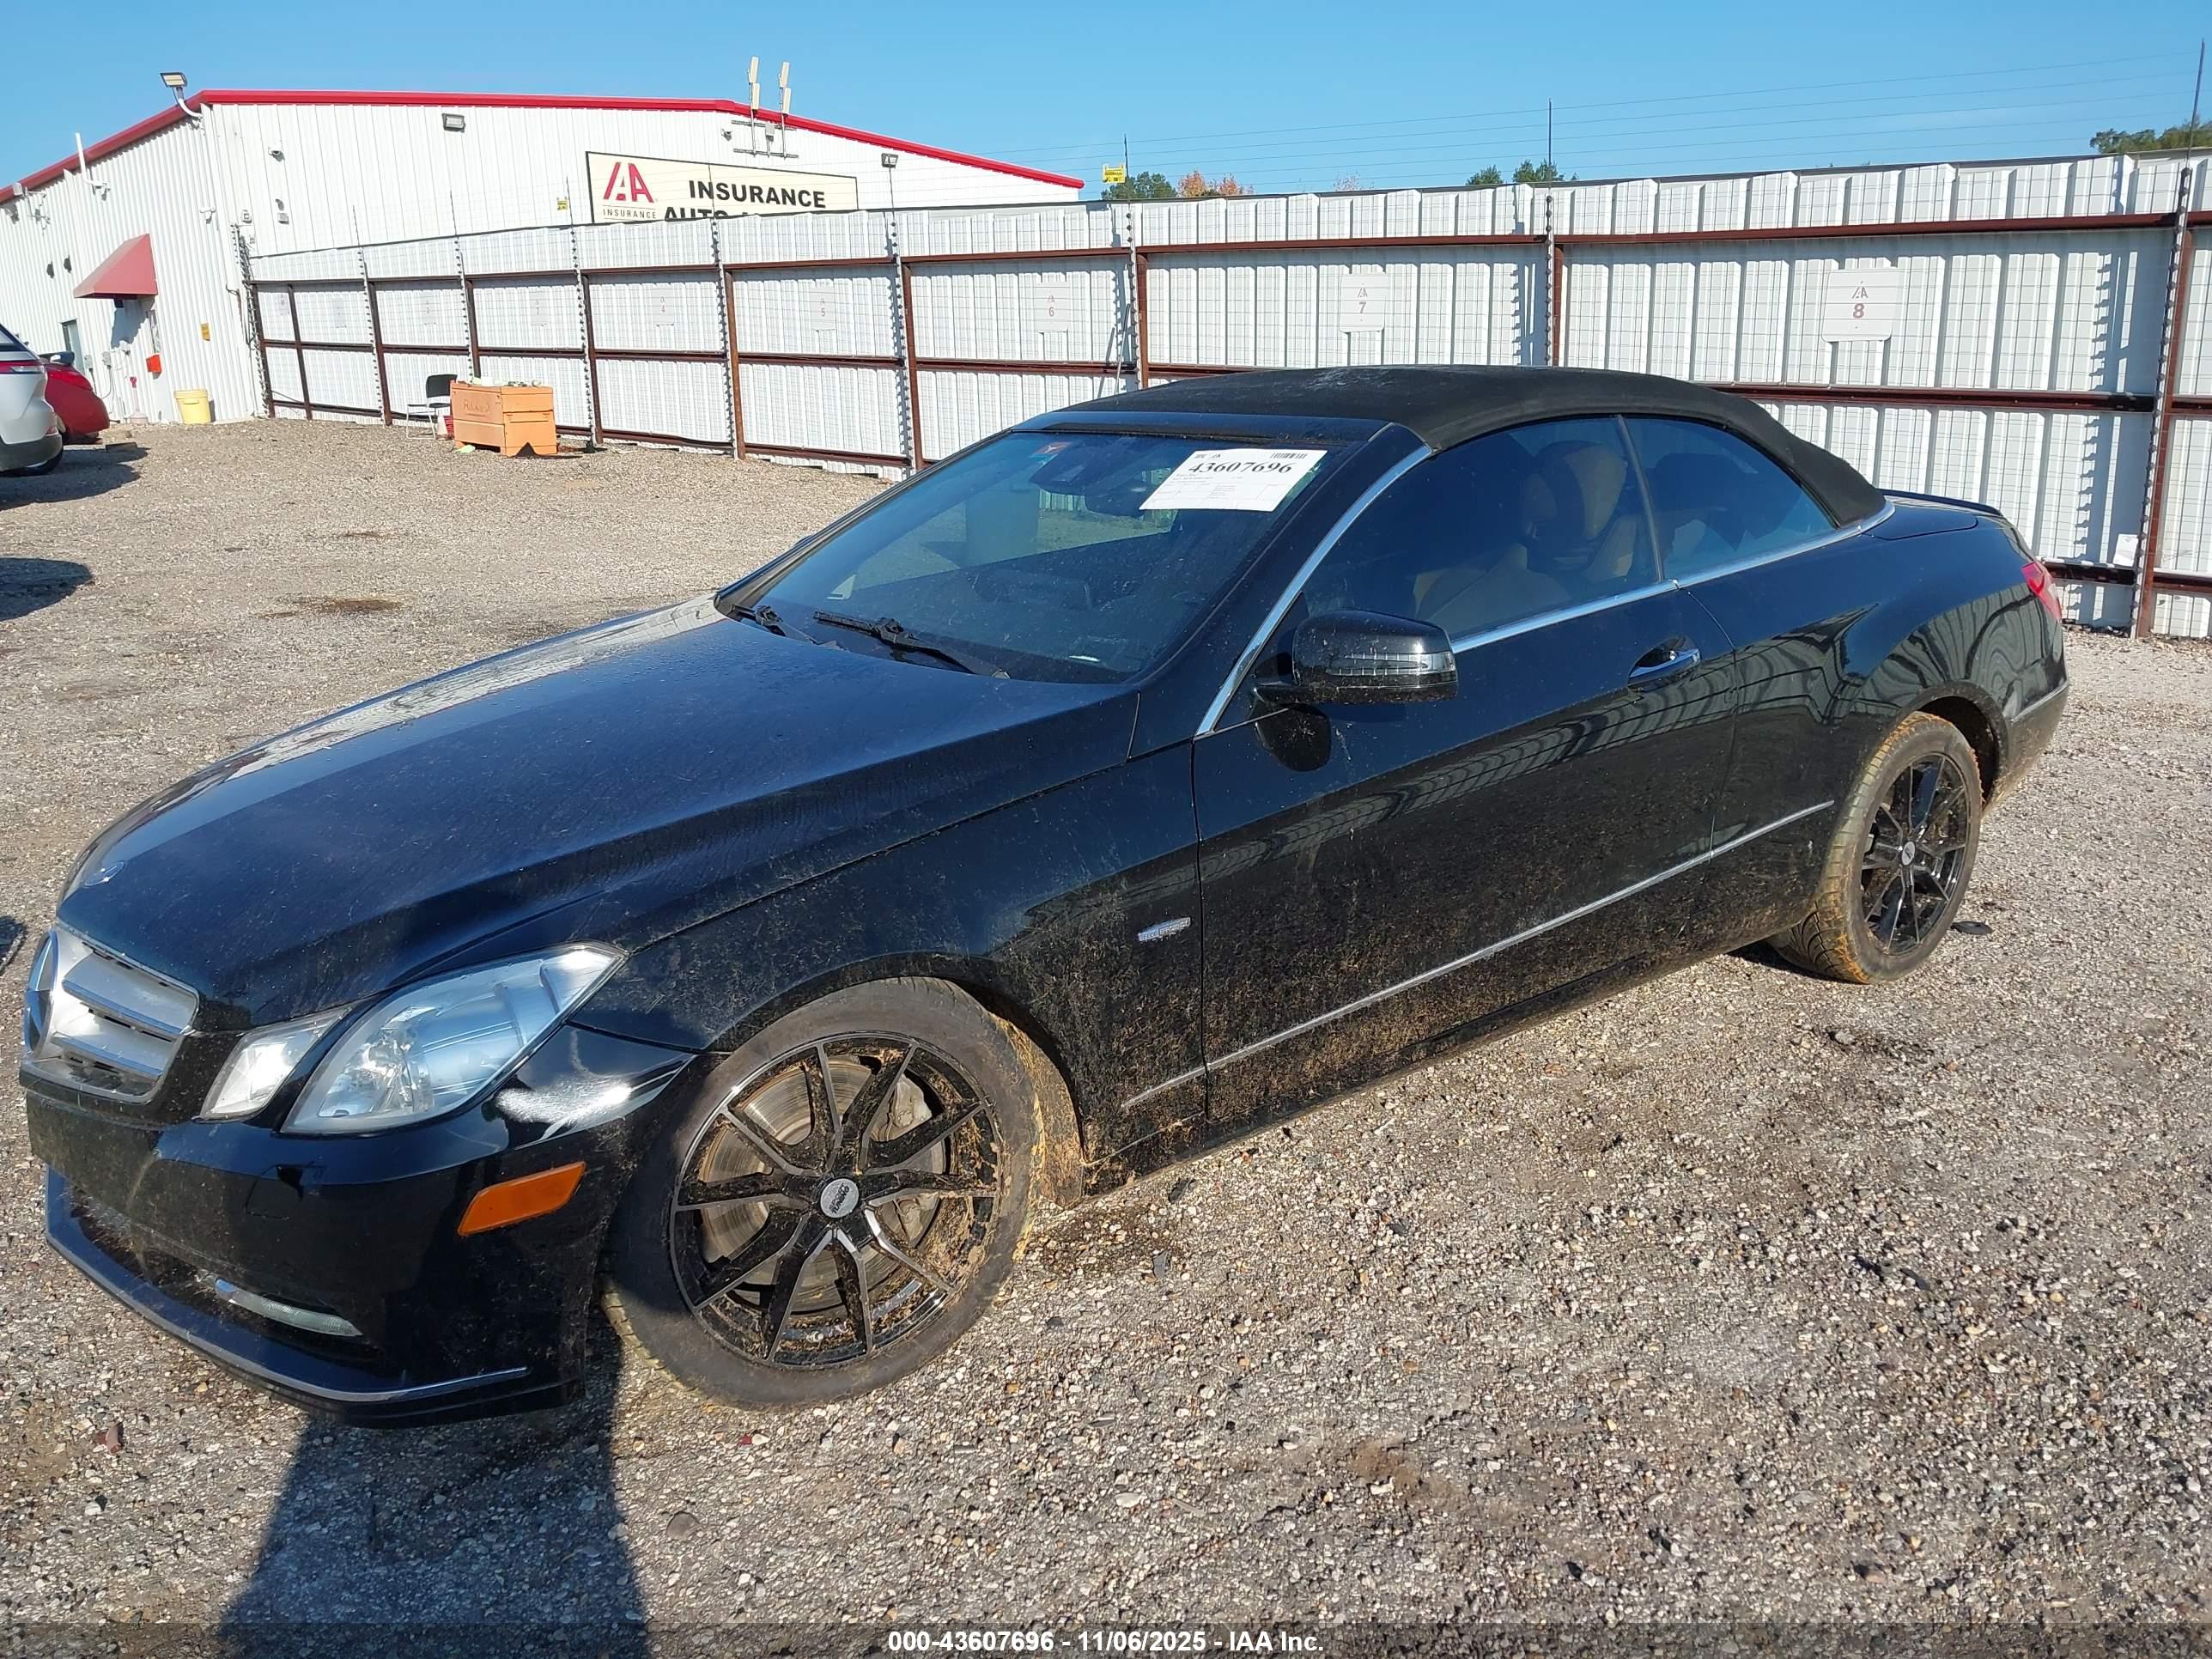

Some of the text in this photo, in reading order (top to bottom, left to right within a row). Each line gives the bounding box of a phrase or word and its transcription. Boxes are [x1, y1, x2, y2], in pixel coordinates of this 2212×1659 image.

[689, 179, 826, 209] INSURANCE
[602, 208, 657, 219] INSURANCE
[1048, 307, 1055, 317] 6
[1358, 301, 1367, 313] 7
[1853, 303, 1864, 319] 8
[1188, 462, 1296, 473] 43607696
